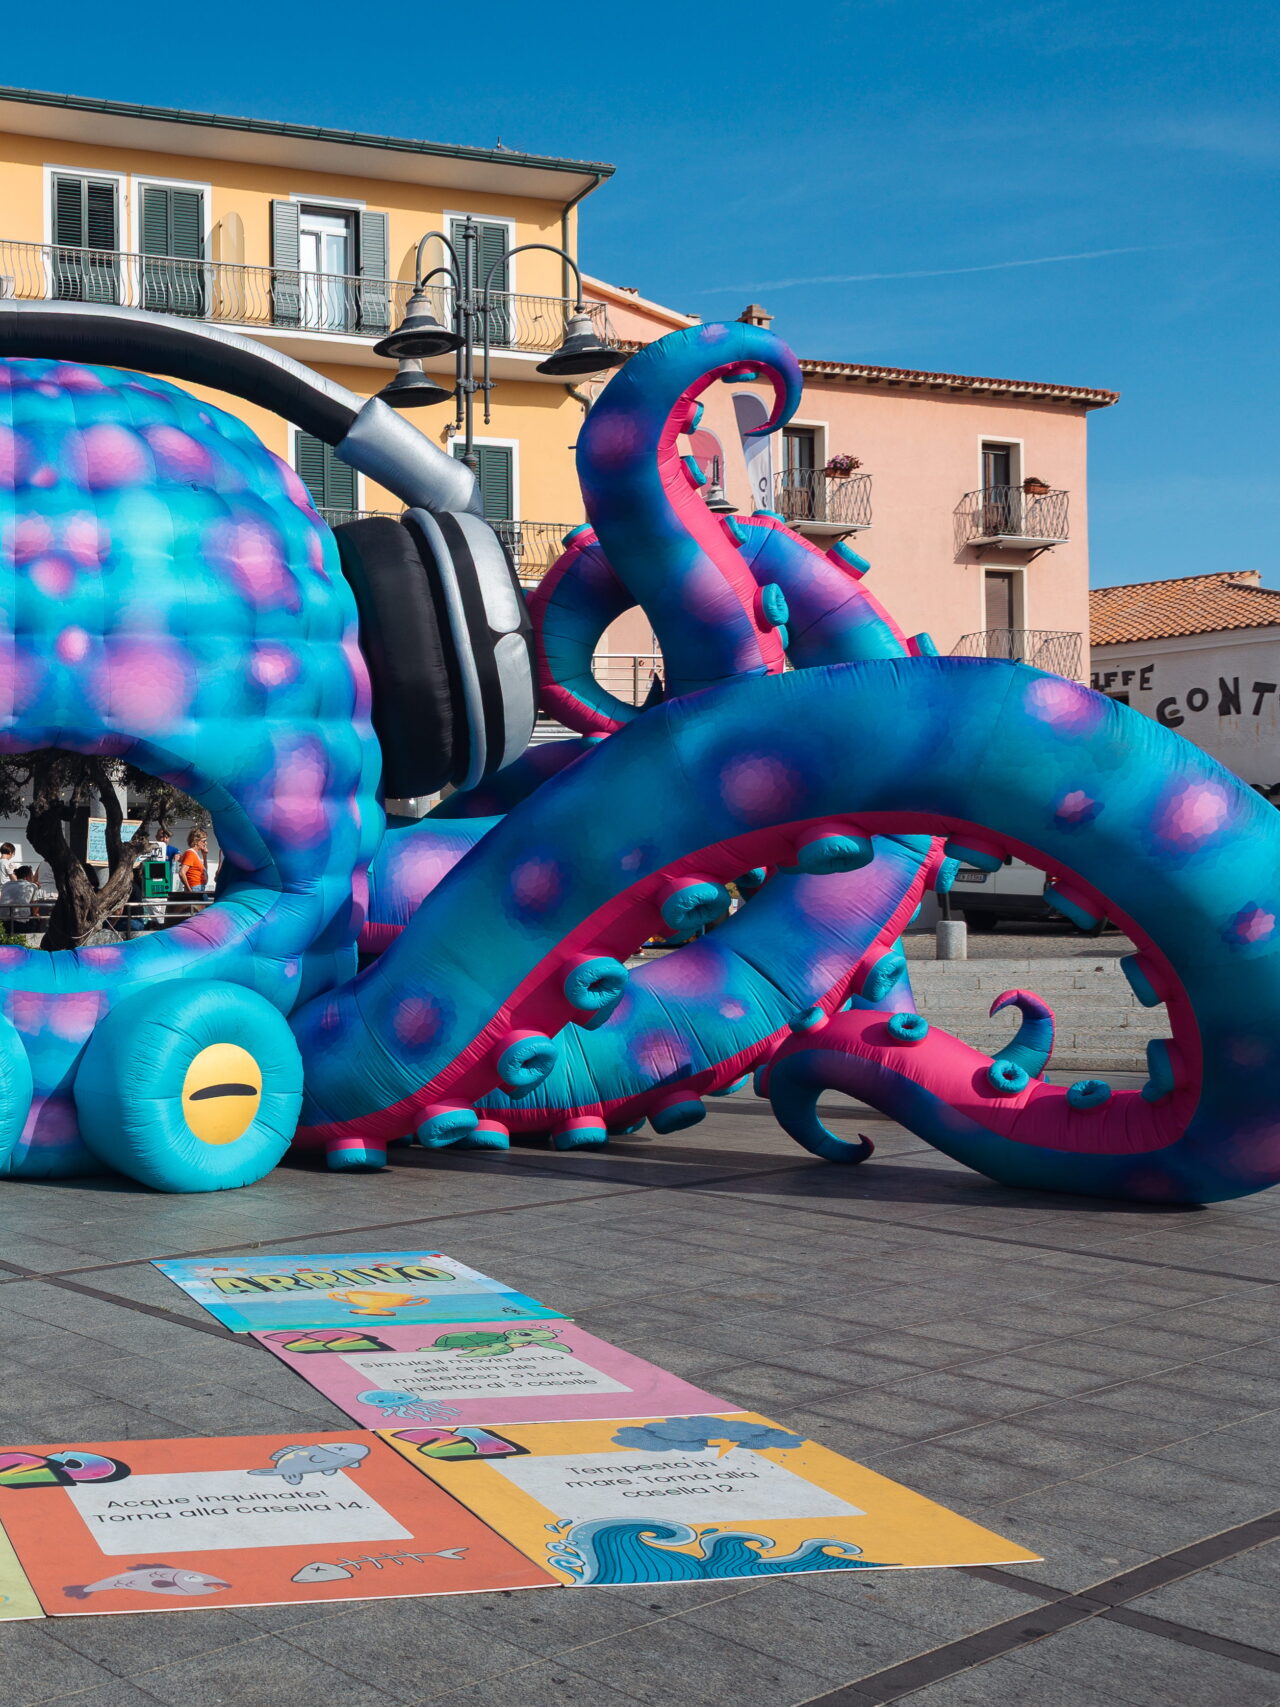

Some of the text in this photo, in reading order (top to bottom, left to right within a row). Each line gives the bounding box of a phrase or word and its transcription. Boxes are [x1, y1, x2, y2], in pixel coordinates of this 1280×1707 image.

[210, 1265, 456, 1295] ARRIVO
[360, 1361, 432, 1370] Simula
[448, 1355, 566, 1365] movimento
[455, 1363, 538, 1373] animale
[392, 1373, 500, 1386] misterioso
[525, 1370, 586, 1379] torna
[401, 1383, 482, 1393] indietro
[486, 1380, 505, 1389] di
[527, 1378, 598, 1388] caselle
[390, 1427, 532, 1462] 21
[564, 1459, 718, 1477] Tempesta in
[641, 1473, 711, 1484] Torna
[718, 1468, 761, 1480] alla
[106, 1488, 330, 1511] Acque inquinate!
[622, 1486, 708, 1499] casella
[92, 1511, 173, 1523] Torna
[178, 1507, 229, 1518] alla
[236, 1503, 331, 1516] casella
